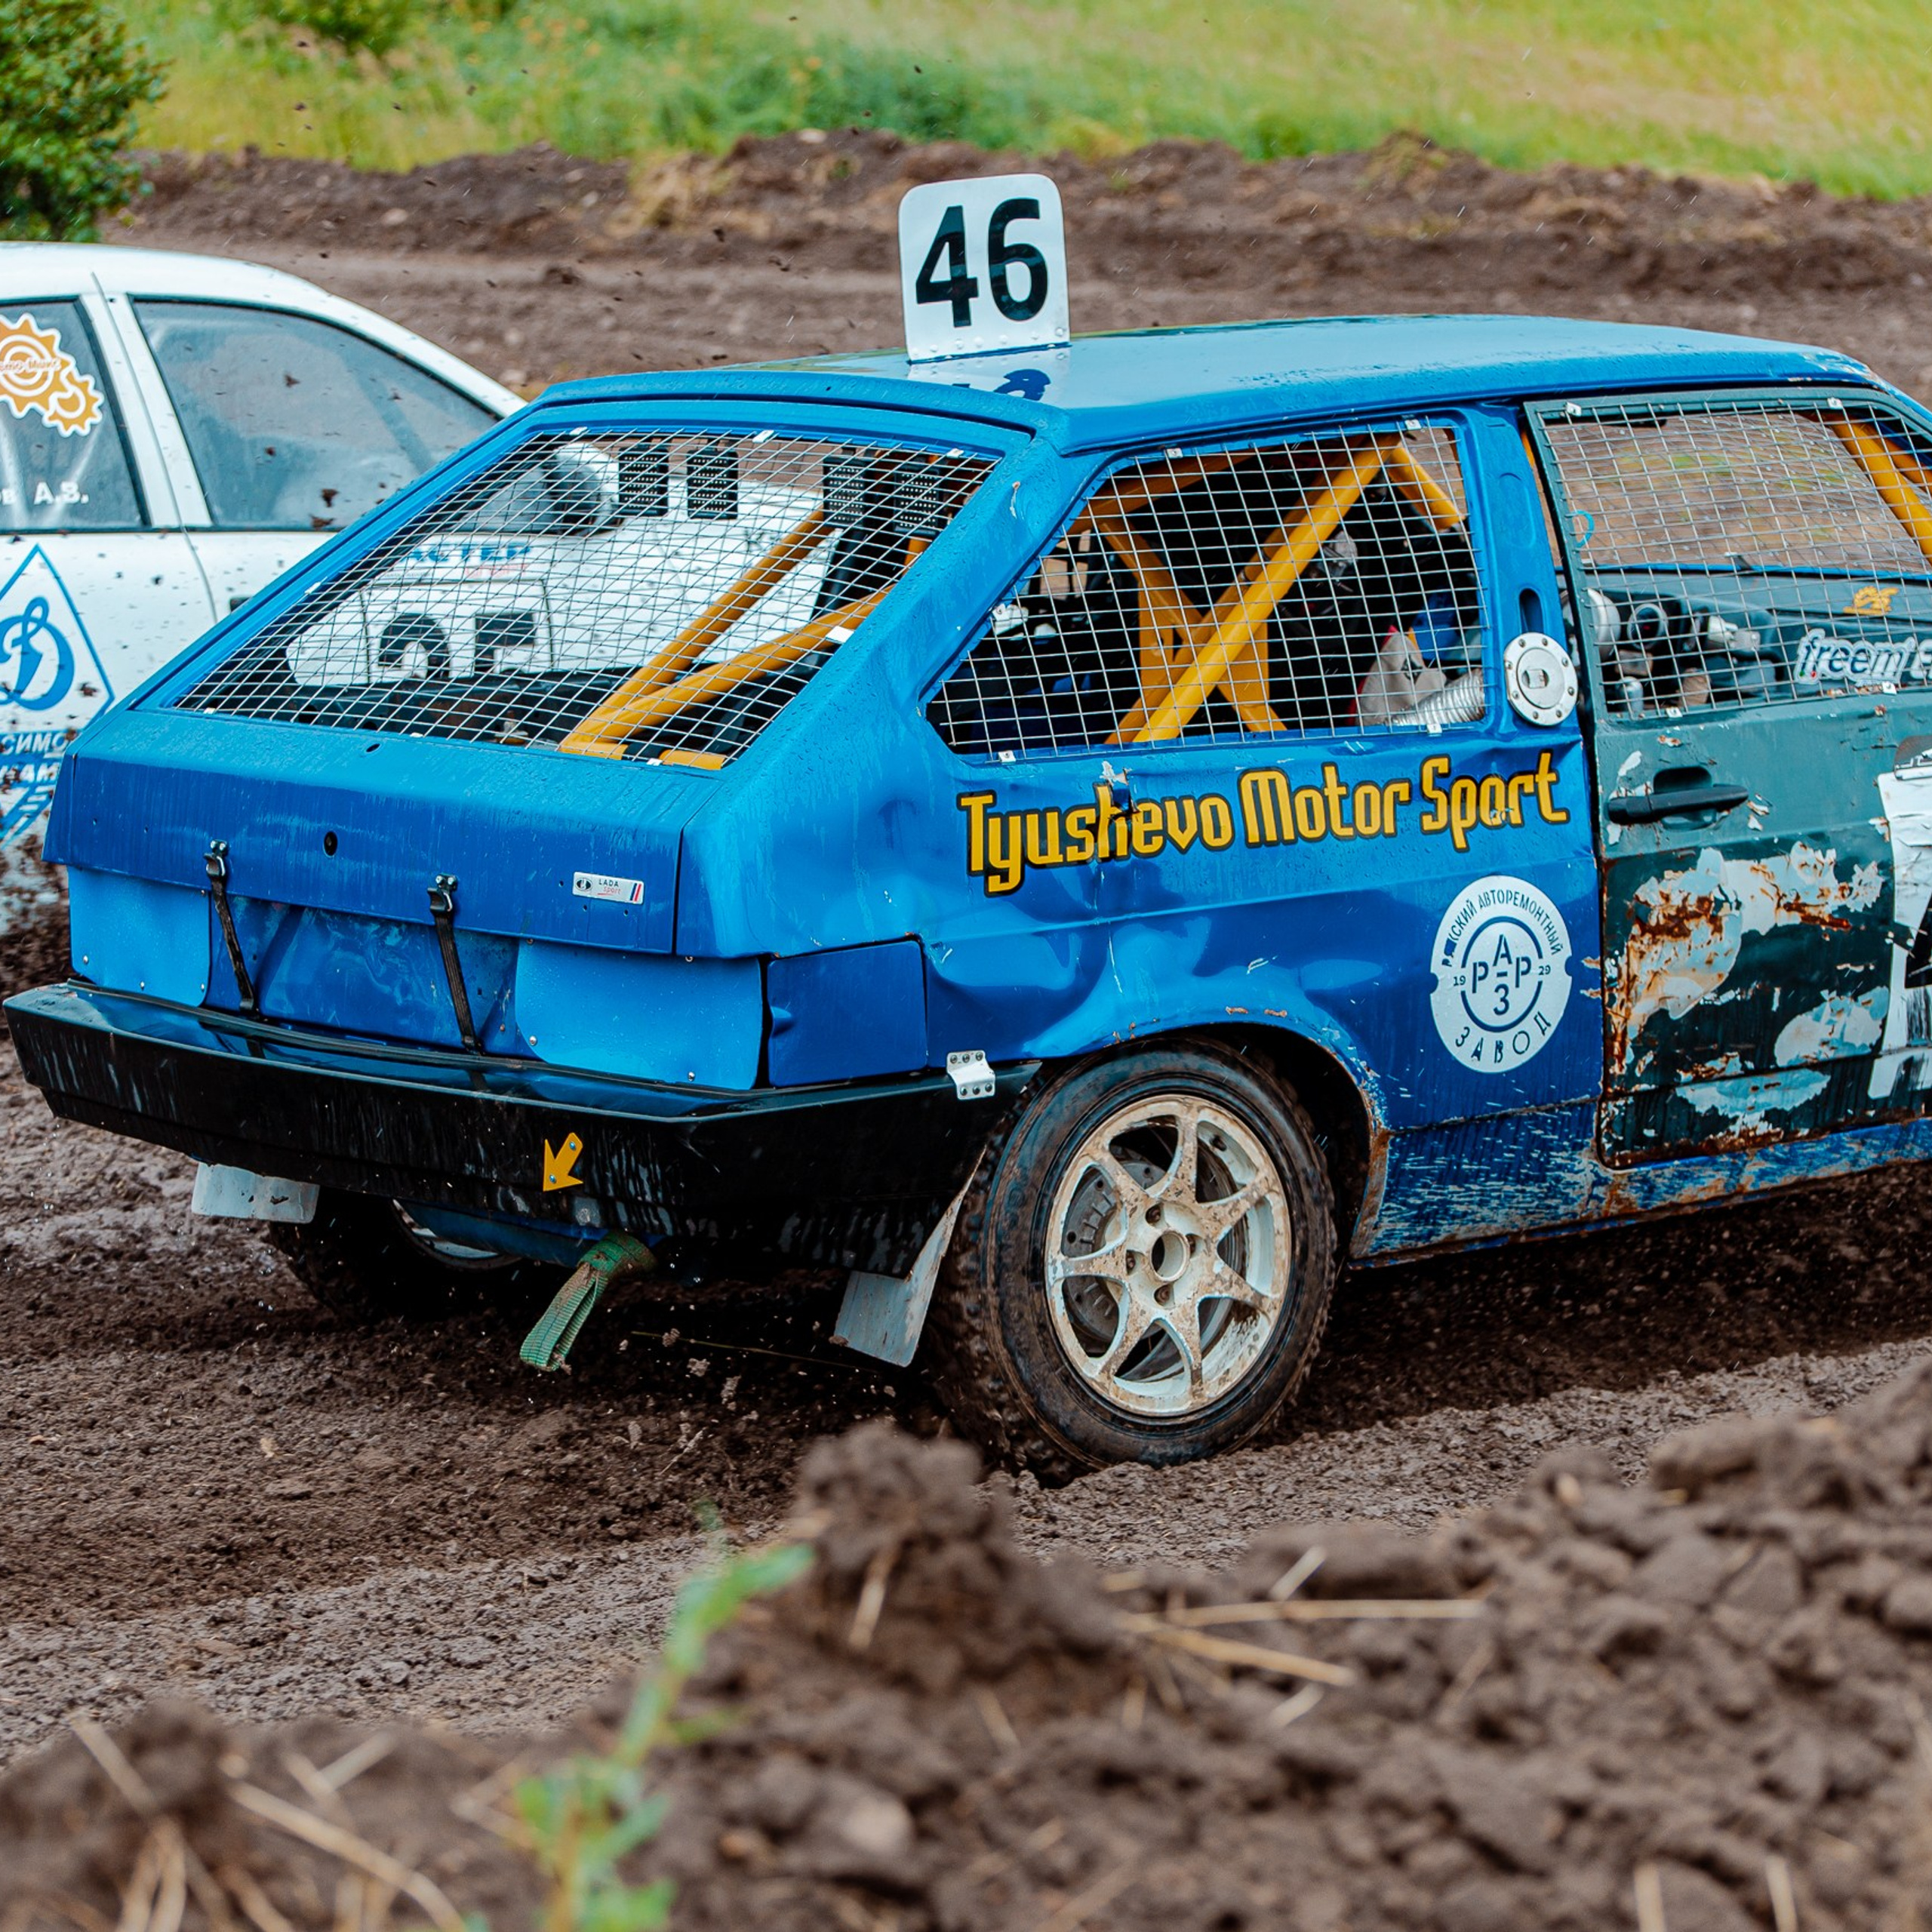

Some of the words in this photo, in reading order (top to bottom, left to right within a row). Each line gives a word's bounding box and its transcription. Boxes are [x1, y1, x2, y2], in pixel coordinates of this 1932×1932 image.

[915, 197, 1048, 328] 46
[958, 780, 1235, 897] Tyushevo
[1238, 762, 1413, 848] Motor
[1418, 750, 1571, 853] Sport
[598, 878, 619, 888] LADA
[1478, 889, 1564, 955] АВТОРЕМОНТНЫЙ
[1453, 976, 1466, 986] 19
[1538, 965, 1552, 976] 29
[1455, 1011, 1552, 1063] ЗАВОД
